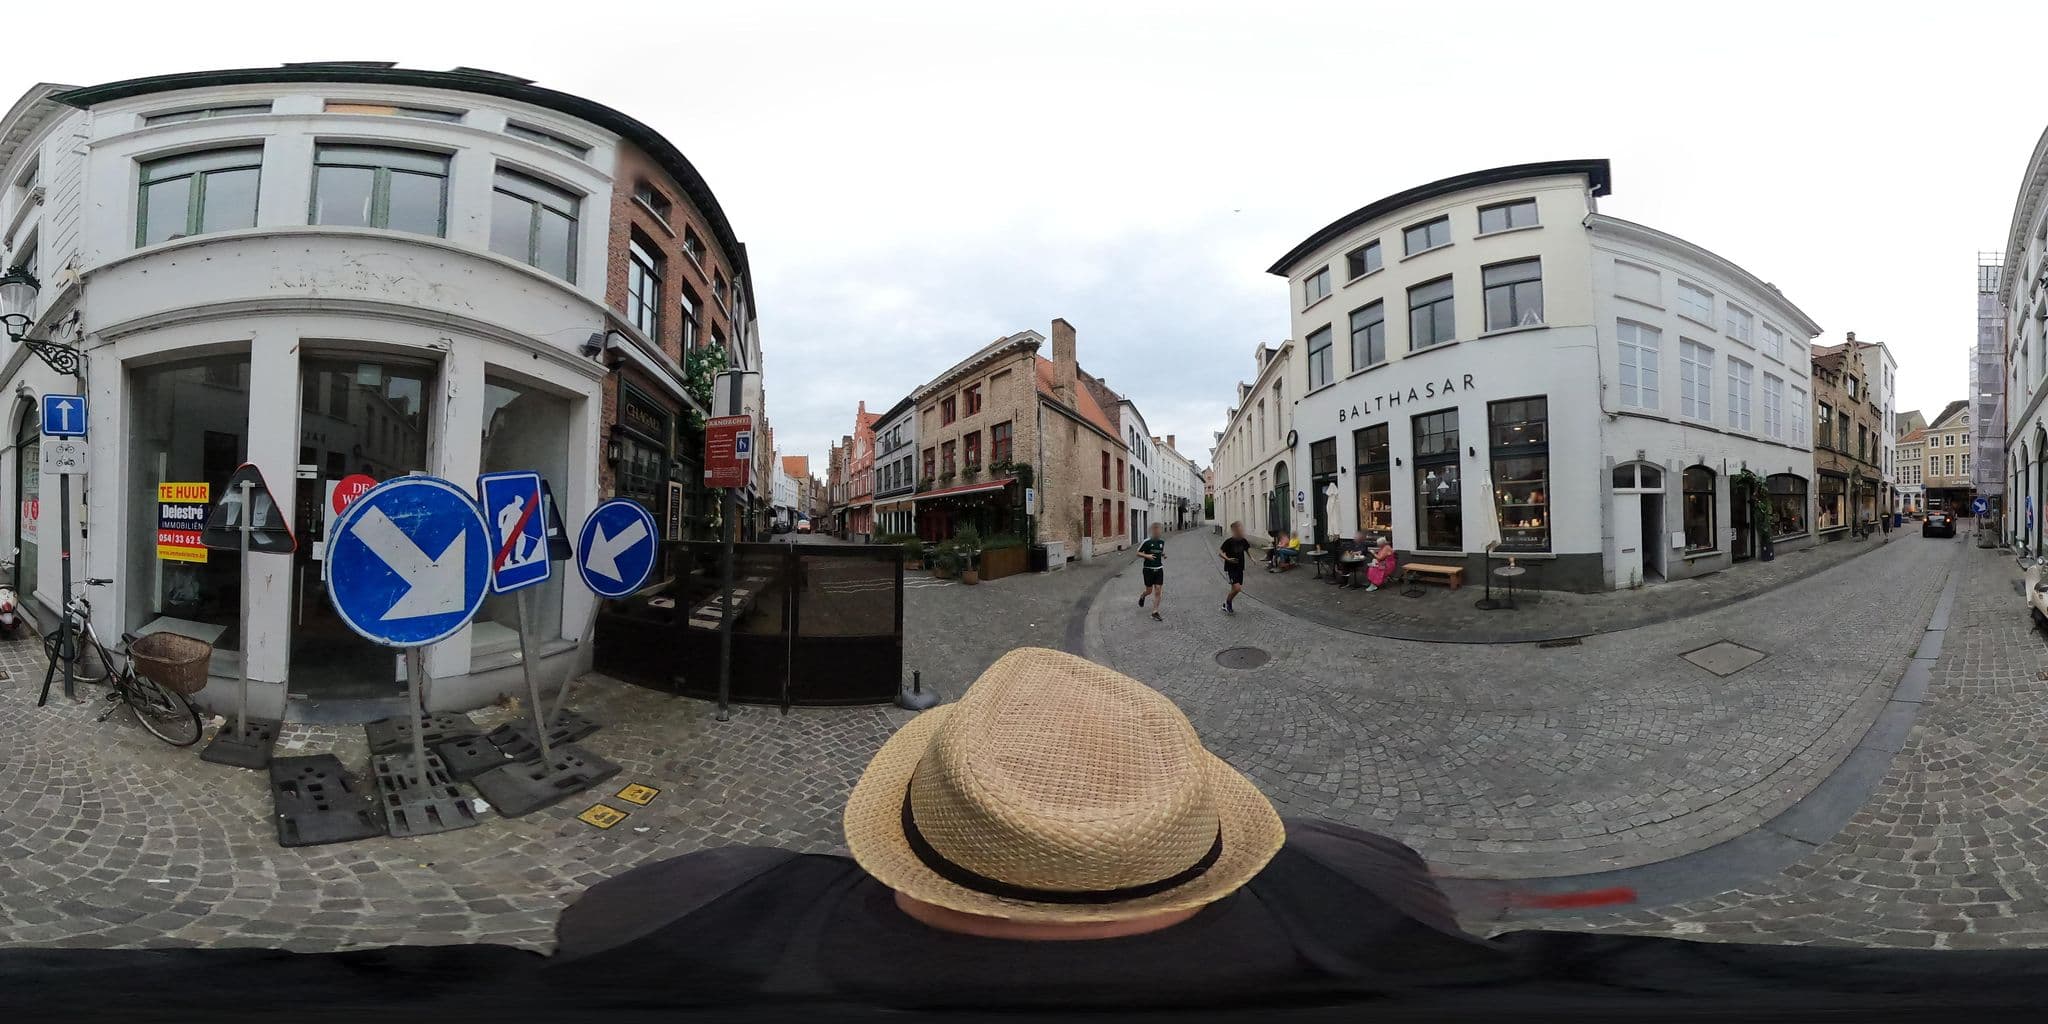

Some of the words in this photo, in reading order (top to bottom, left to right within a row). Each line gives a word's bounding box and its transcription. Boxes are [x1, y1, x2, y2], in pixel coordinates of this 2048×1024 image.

[1339, 374, 1475, 422] BALTHASAR
[160, 486, 173, 498] TE
[176, 486, 207, 499] HUUR
[162, 504, 204, 520] Delestré
[185, 535, 196, 544] 62
